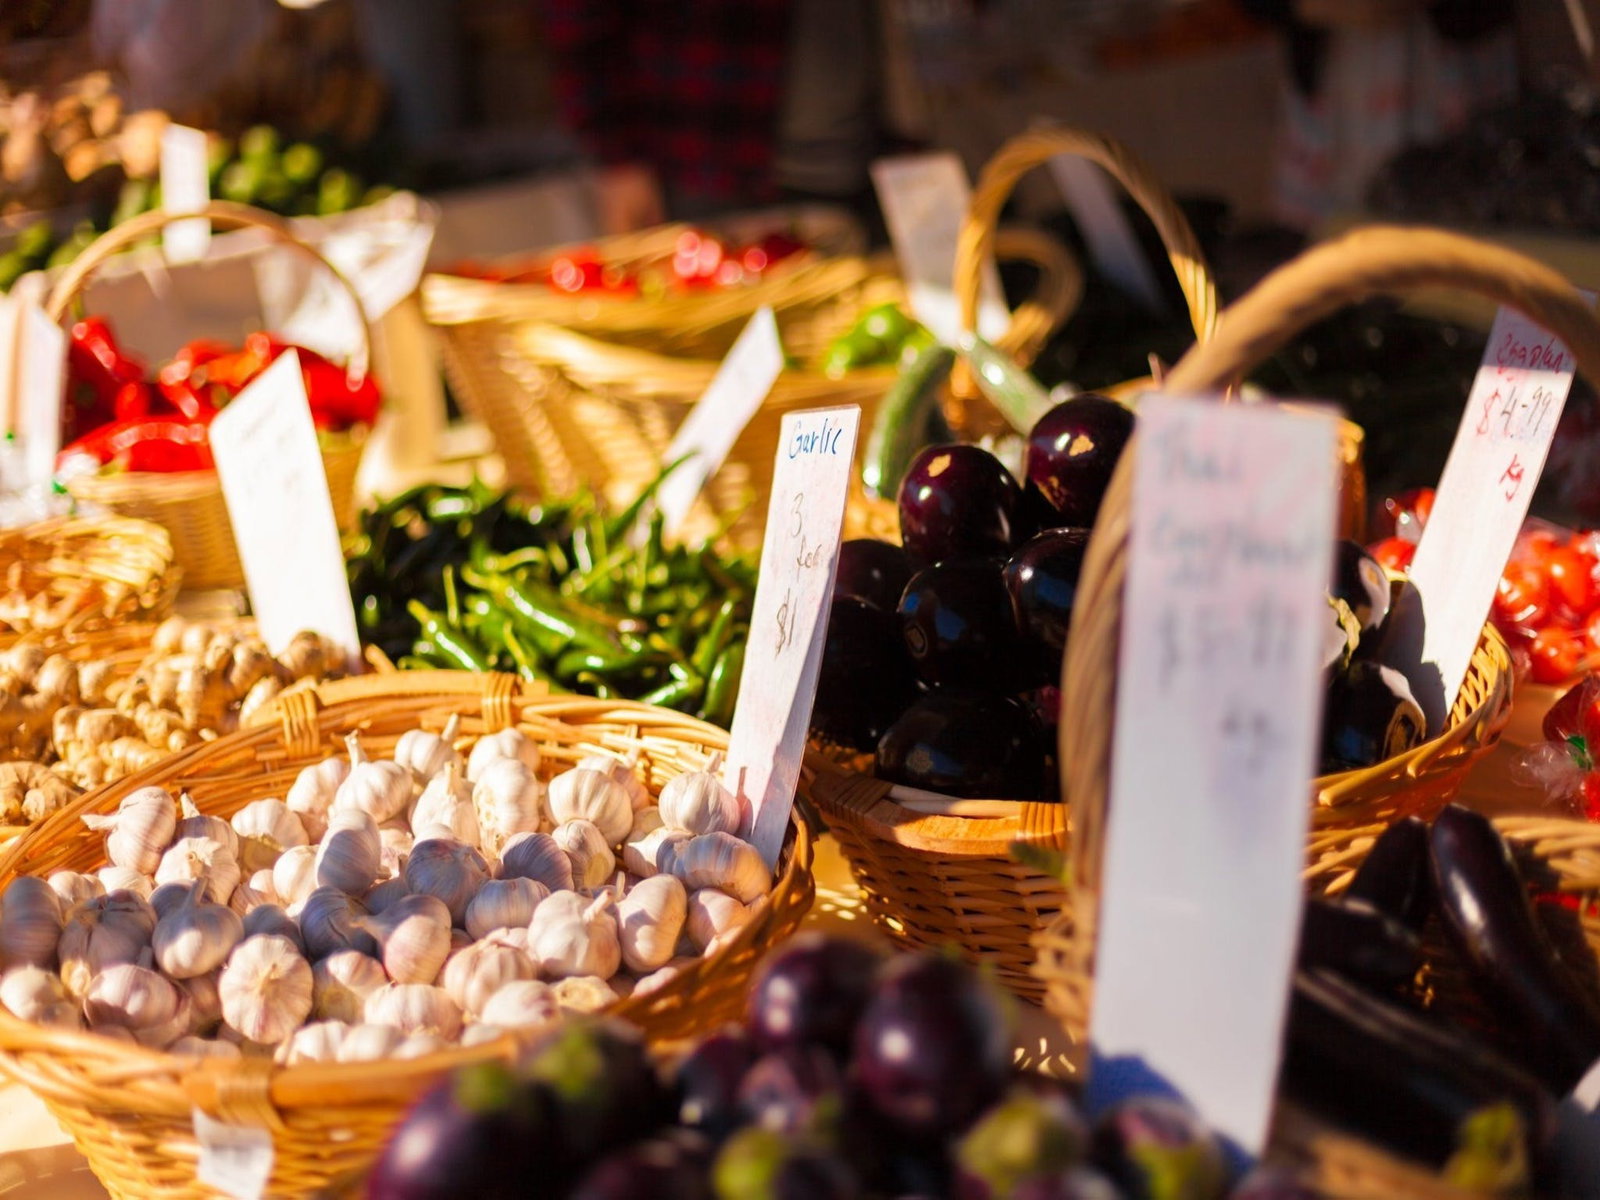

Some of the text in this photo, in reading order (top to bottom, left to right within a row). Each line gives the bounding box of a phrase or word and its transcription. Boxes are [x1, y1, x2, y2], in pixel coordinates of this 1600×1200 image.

[788, 417, 842, 459] Garlic
[1499, 453, 1525, 501] kg
[790, 493, 804, 538] 3
[774, 587, 798, 661] $1
